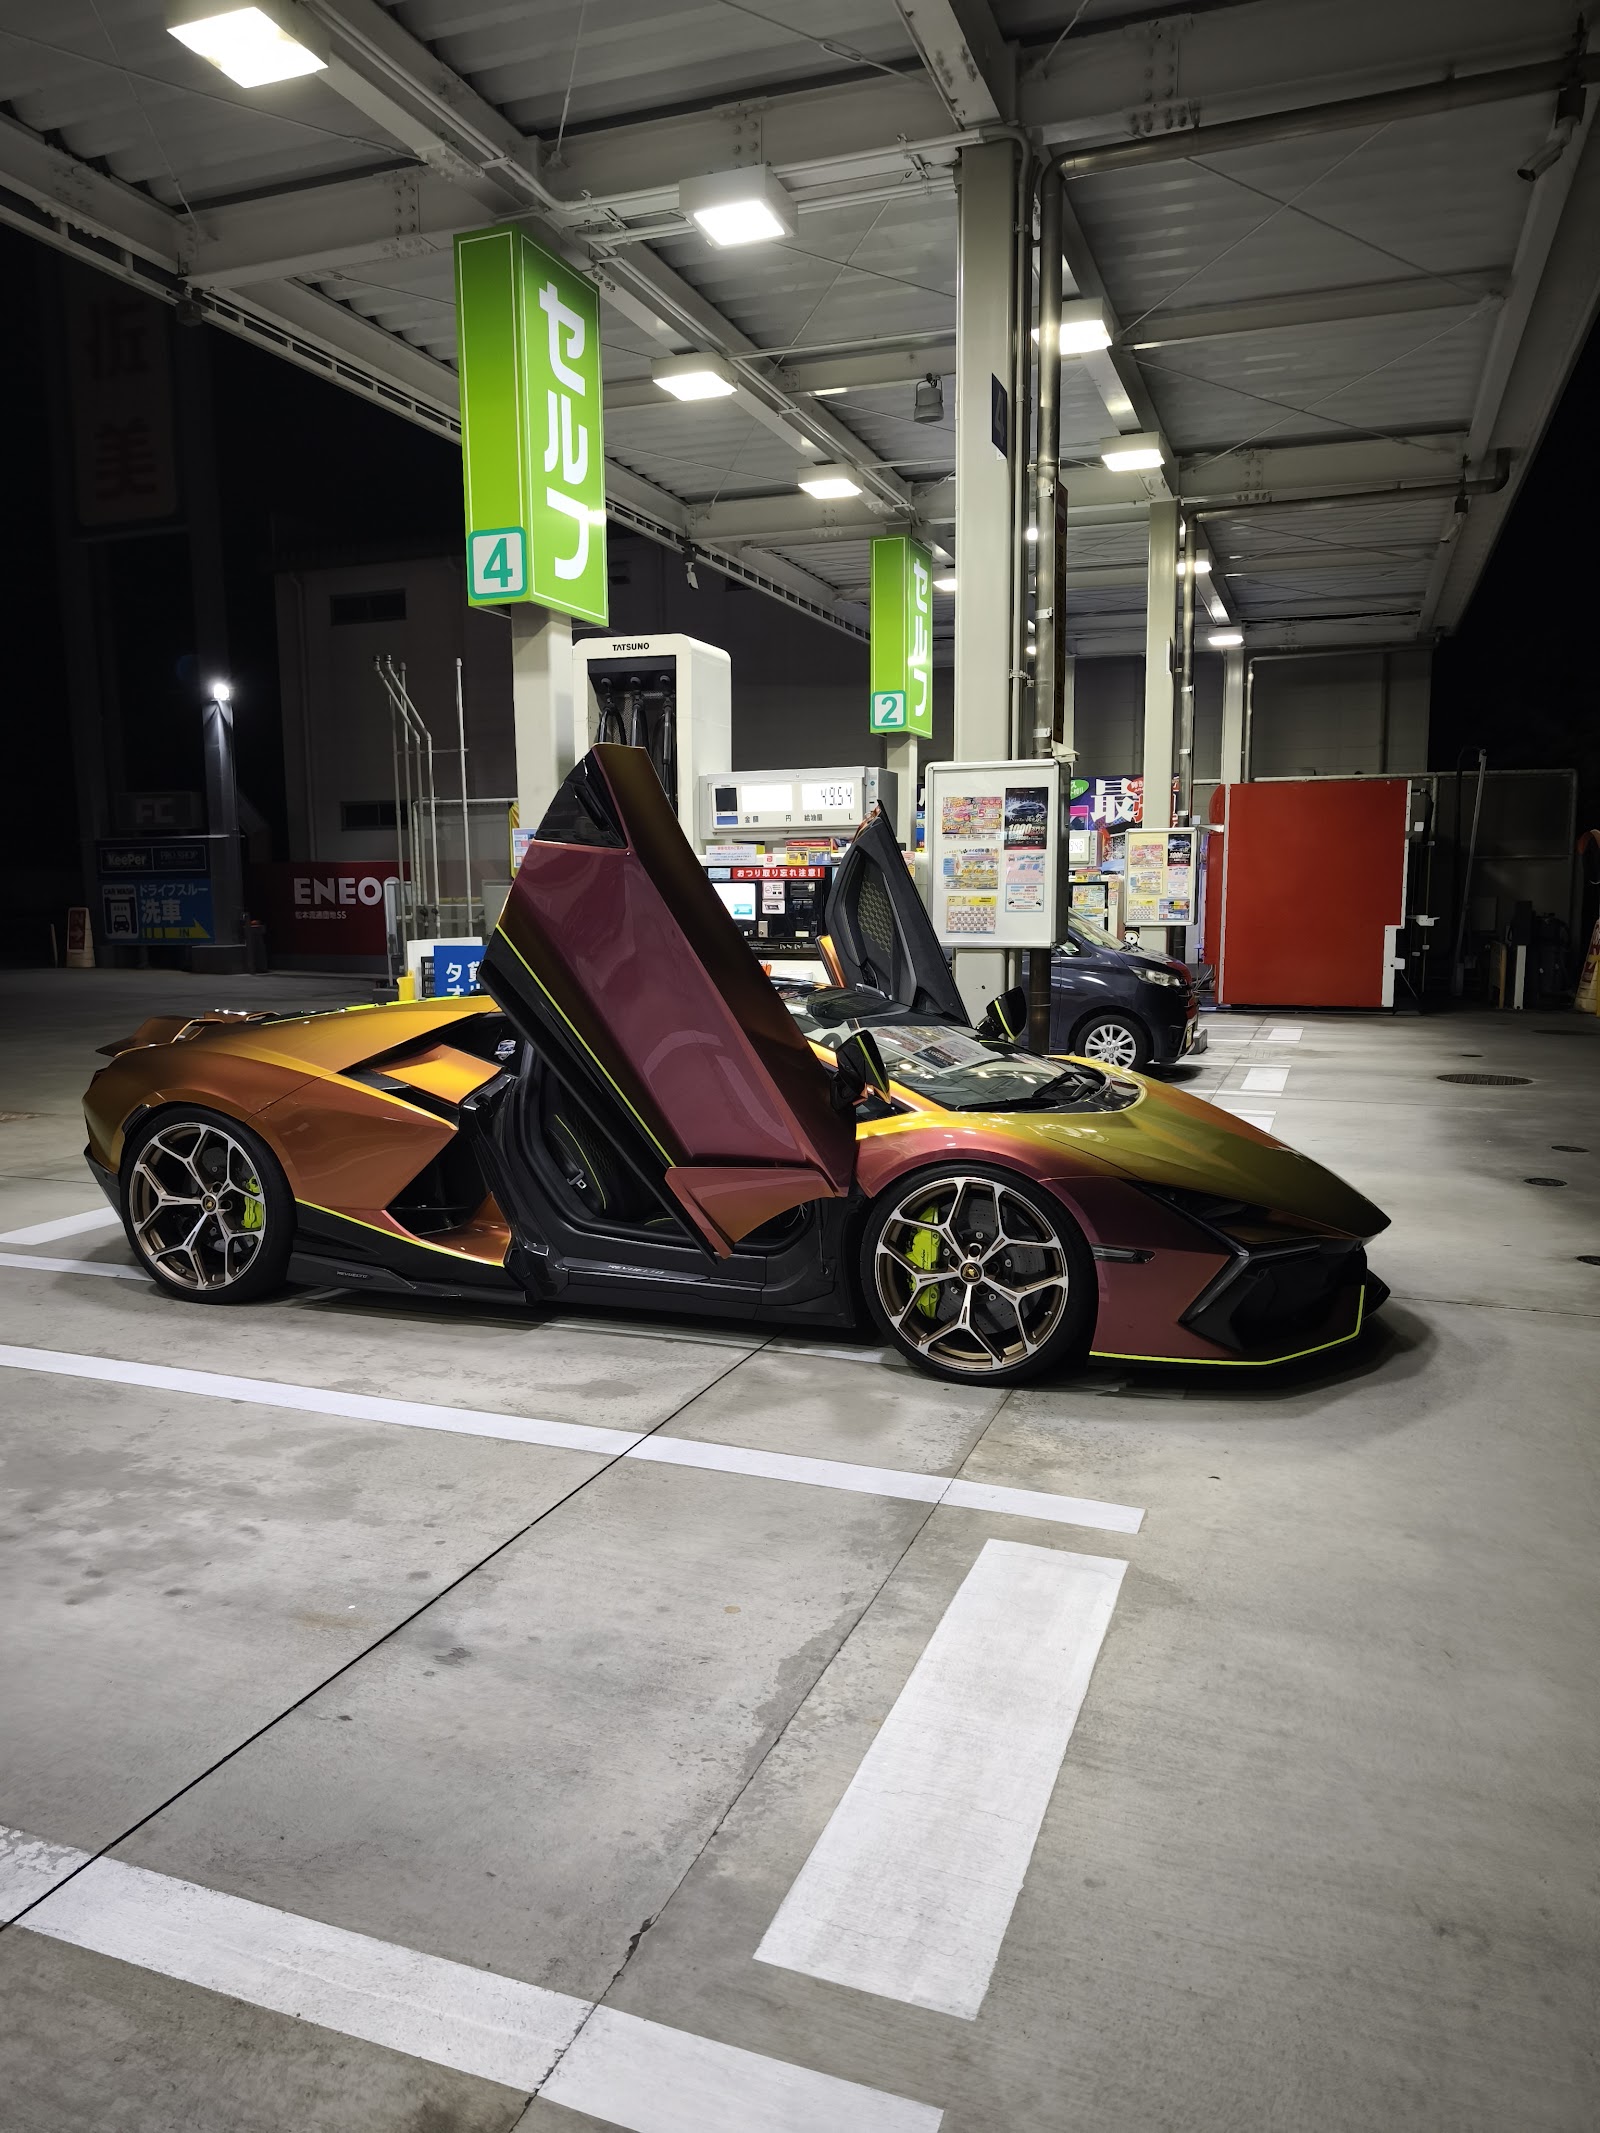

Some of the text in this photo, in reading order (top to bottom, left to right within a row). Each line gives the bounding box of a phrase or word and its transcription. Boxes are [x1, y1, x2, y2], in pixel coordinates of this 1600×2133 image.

[538, 280, 589, 581] セルフ
[483, 536, 513, 588] 4
[612, 642, 650, 652] TATSUNO
[881, 696, 898, 724] 2
[1090, 777, 1144, 824] 最
[785, 814, 792, 822] 円
[848, 812, 853, 821] L
[107, 853, 145, 866] KeePer
[139, 881, 208, 897] ドライブスルー
[293, 876, 400, 906] ENEO
[141, 898, 182, 925] 洗車
